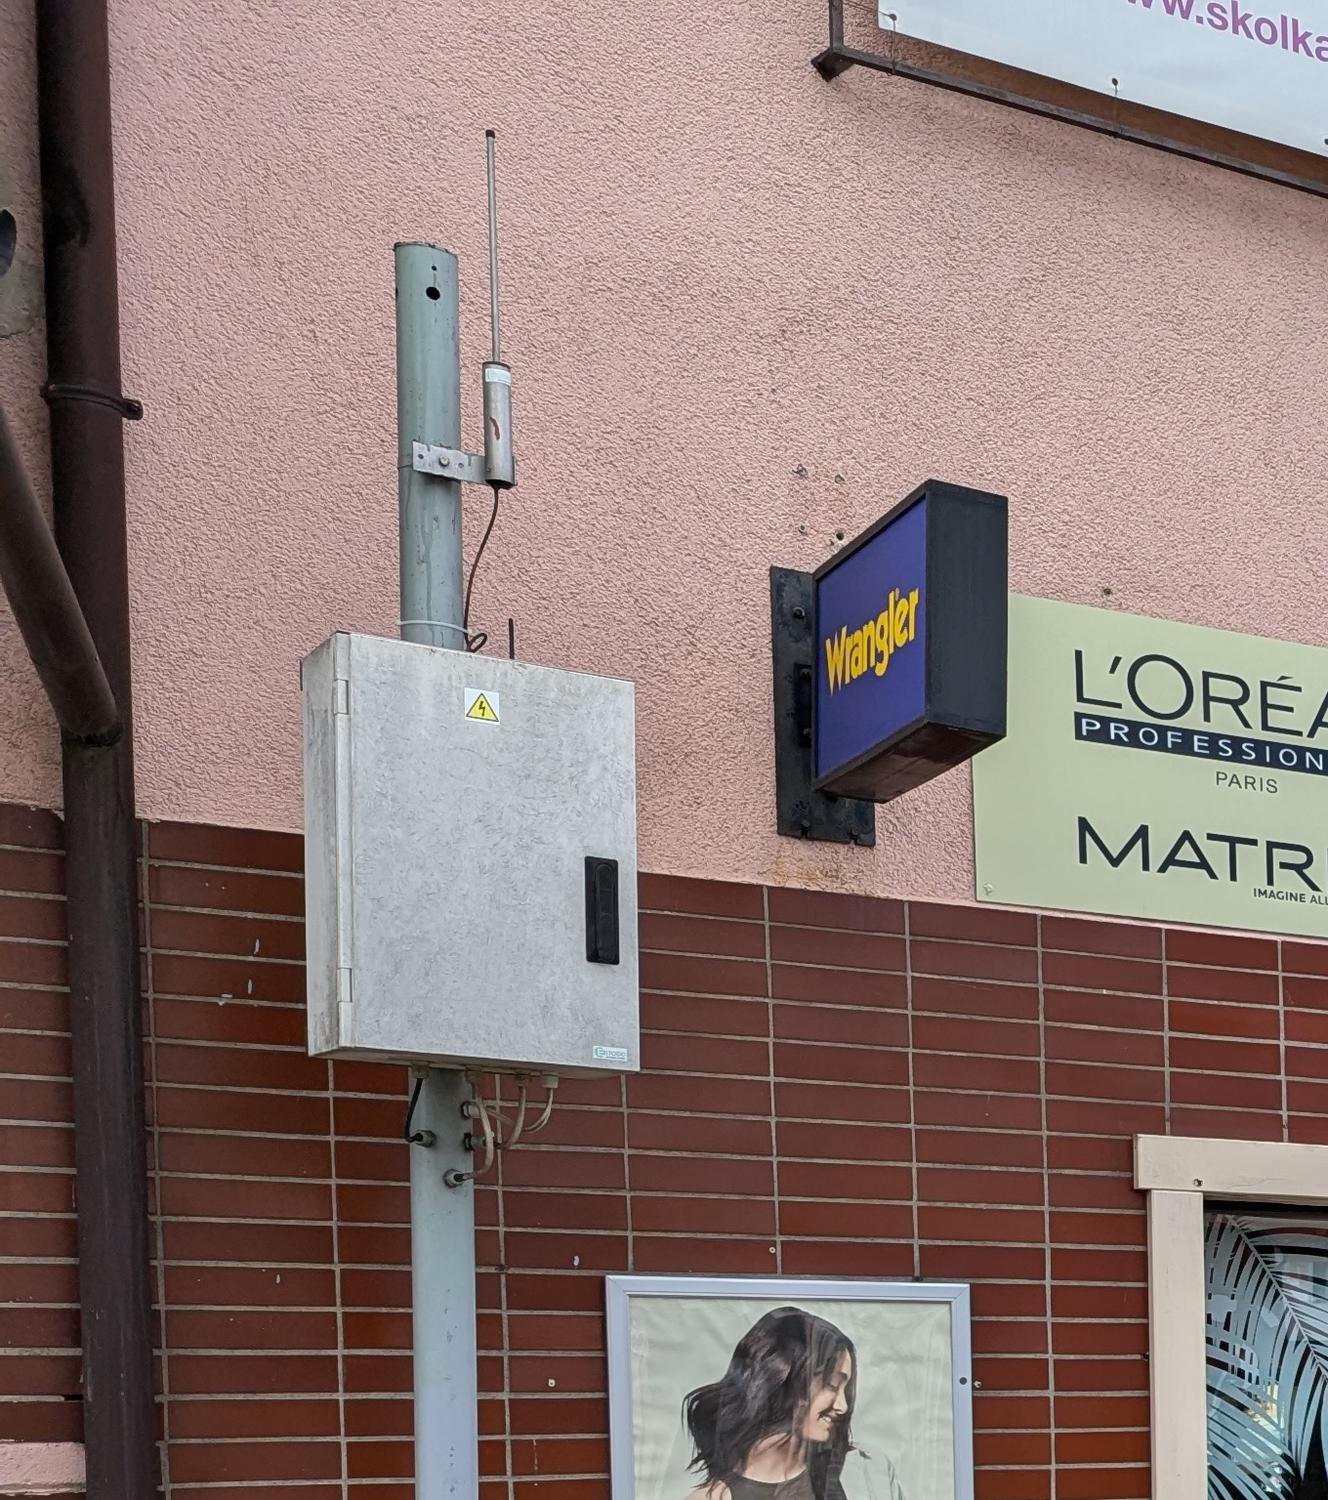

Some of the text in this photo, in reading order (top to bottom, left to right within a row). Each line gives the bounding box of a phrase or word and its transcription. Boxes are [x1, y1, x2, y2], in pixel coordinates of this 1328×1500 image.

[826, 587, 919, 697] Wrangler
[1215, 771, 1278, 795] PARIS
[1253, 887, 1306, 903] IMAGINE
